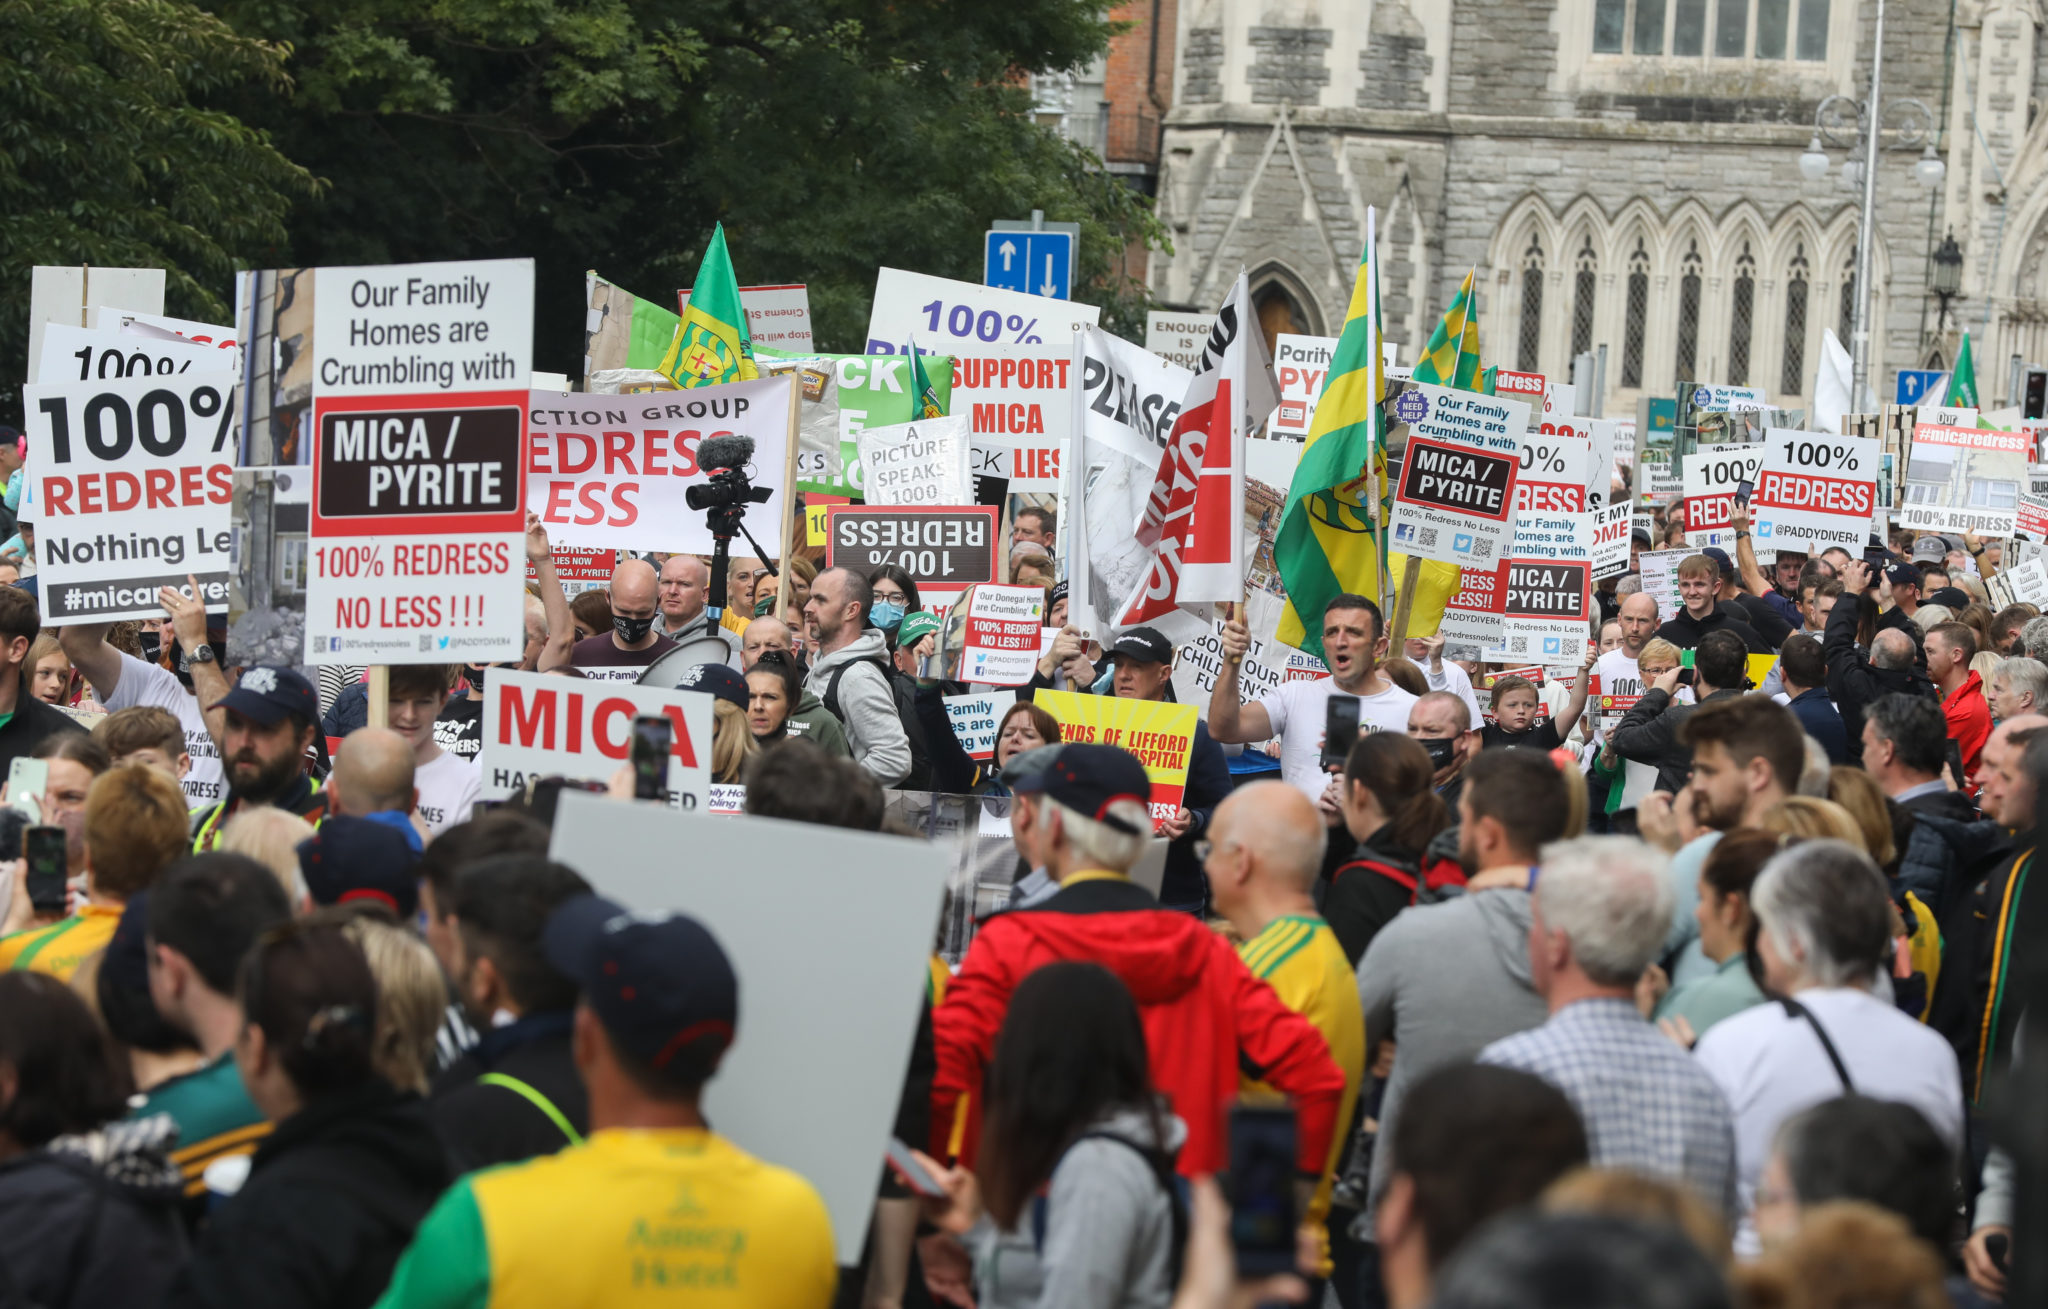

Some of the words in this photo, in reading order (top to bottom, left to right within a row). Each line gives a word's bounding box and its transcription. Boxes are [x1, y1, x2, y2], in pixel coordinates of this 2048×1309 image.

[351, 281, 399, 308] Our
[407, 277, 490, 310] Family
[350, 319, 440, 347] Homes
[449, 321, 489, 343] are
[767, 331, 786, 342] will
[1179, 338, 1193, 349] IS
[321, 356, 454, 389] Crumbling
[462, 352, 516, 382] with
[836, 357, 904, 394] CK
[952, 358, 1071, 390] SUPPORT
[1083, 355, 1184, 450] PLEASE
[1407, 393, 1420, 402] WE
[1715, 388, 1729, 397] Our
[1730, 390, 1755, 400] Family
[530, 408, 627, 426] CTION
[641, 397, 750, 420] GROUP
[1402, 402, 1423, 411] NEED
[1402, 411, 1422, 420] HELP
[1438, 395, 1463, 410] Our
[1465, 400, 1510, 421] Family
[39, 385, 234, 464] 100%
[972, 403, 1044, 434] MICA
[1434, 409, 1481, 429] Homes
[1484, 420, 1506, 434] are
[1937, 412, 1957, 425] Our
[333, 416, 431, 462] MICA
[905, 426, 919, 442] A
[1418, 423, 1484, 446] crumbling
[1488, 436, 1516, 451] with
[1919, 427, 2026, 450] #micaredress
[529, 428, 735, 478] EDRES
[871, 438, 949, 467] PICTURE
[1012, 448, 1060, 479] LIES
[1519, 444, 1566, 473] 0%
[1783, 441, 1859, 471] 100%
[877, 461, 947, 488] SPEAKS
[1417, 450, 1476, 480] MICA
[42, 463, 233, 517] REDRES
[369, 461, 503, 508] PYRITE
[892, 484, 938, 506] 1000
[1418, 474, 1502, 509] PYRITE
[1651, 484, 1684, 492] Crumblin
[1763, 475, 1869, 513] REDRESS
[543, 480, 640, 528] ESS
[1516, 484, 1579, 513] RESS
[1398, 507, 1423, 520] 100%
[1425, 512, 1462, 527] Redress
[1464, 520, 1477, 530] No
[1479, 522, 1501, 535] Less
[1608, 504, 1630, 521] MY
[1689, 493, 1760, 527] REDE
[1535, 518, 1576, 532] Family
[1632, 518, 1651, 528] mes
[1948, 513, 2013, 532] REDRESS
[839, 520, 984, 548] REDRESS
[1554, 533, 1575, 544] are
[1775, 525, 1859, 545] @PADDYDIVER4
[46, 531, 184, 565] Nothing
[197, 527, 231, 554] Le
[550, 545, 606, 555] EDRESS
[1512, 545, 1557, 558] mbling
[1560, 546, 1586, 557] with
[1604, 542, 1627, 554] ACTION
[315, 543, 384, 578] 100%
[393, 541, 510, 577] REDRESS
[553, 556, 570, 566] LIES
[572, 557, 592, 566] NOW
[1596, 552, 1618, 564] GROUP
[581, 568, 611, 578] PYRITE
[1591, 562, 1622, 579] aredress
[1461, 573, 1496, 592] RESS
[975, 604, 989, 612] are
[995, 593, 1026, 605] Donegal
[1505, 590, 1580, 611] PYRITE
[336, 597, 371, 629] NO
[1442, 611, 1501, 626] PADDYDIVER4
[973, 620, 1002, 634] 100%
[1003, 623, 1038, 635] REDRESS
[1513, 622, 1548, 633] Redress
[1550, 624, 1562, 633] No
[1564, 625, 1585, 634] Less
[980, 635, 996, 646] NO
[1244, 659, 1280, 688] OUR
[1307, 657, 1326, 669] HEL
[587, 670, 607, 681] Our
[609, 670, 642, 684] Family
[498, 684, 699, 769] MICA
[970, 718, 995, 730] are
[1059, 723, 1096, 744] ENDS
[1103, 728, 1122, 746] OF
[1128, 731, 1188, 753] LIFFORD
[1124, 748, 1183, 770] OSPITAL
[181, 780, 220, 799] DRESS
